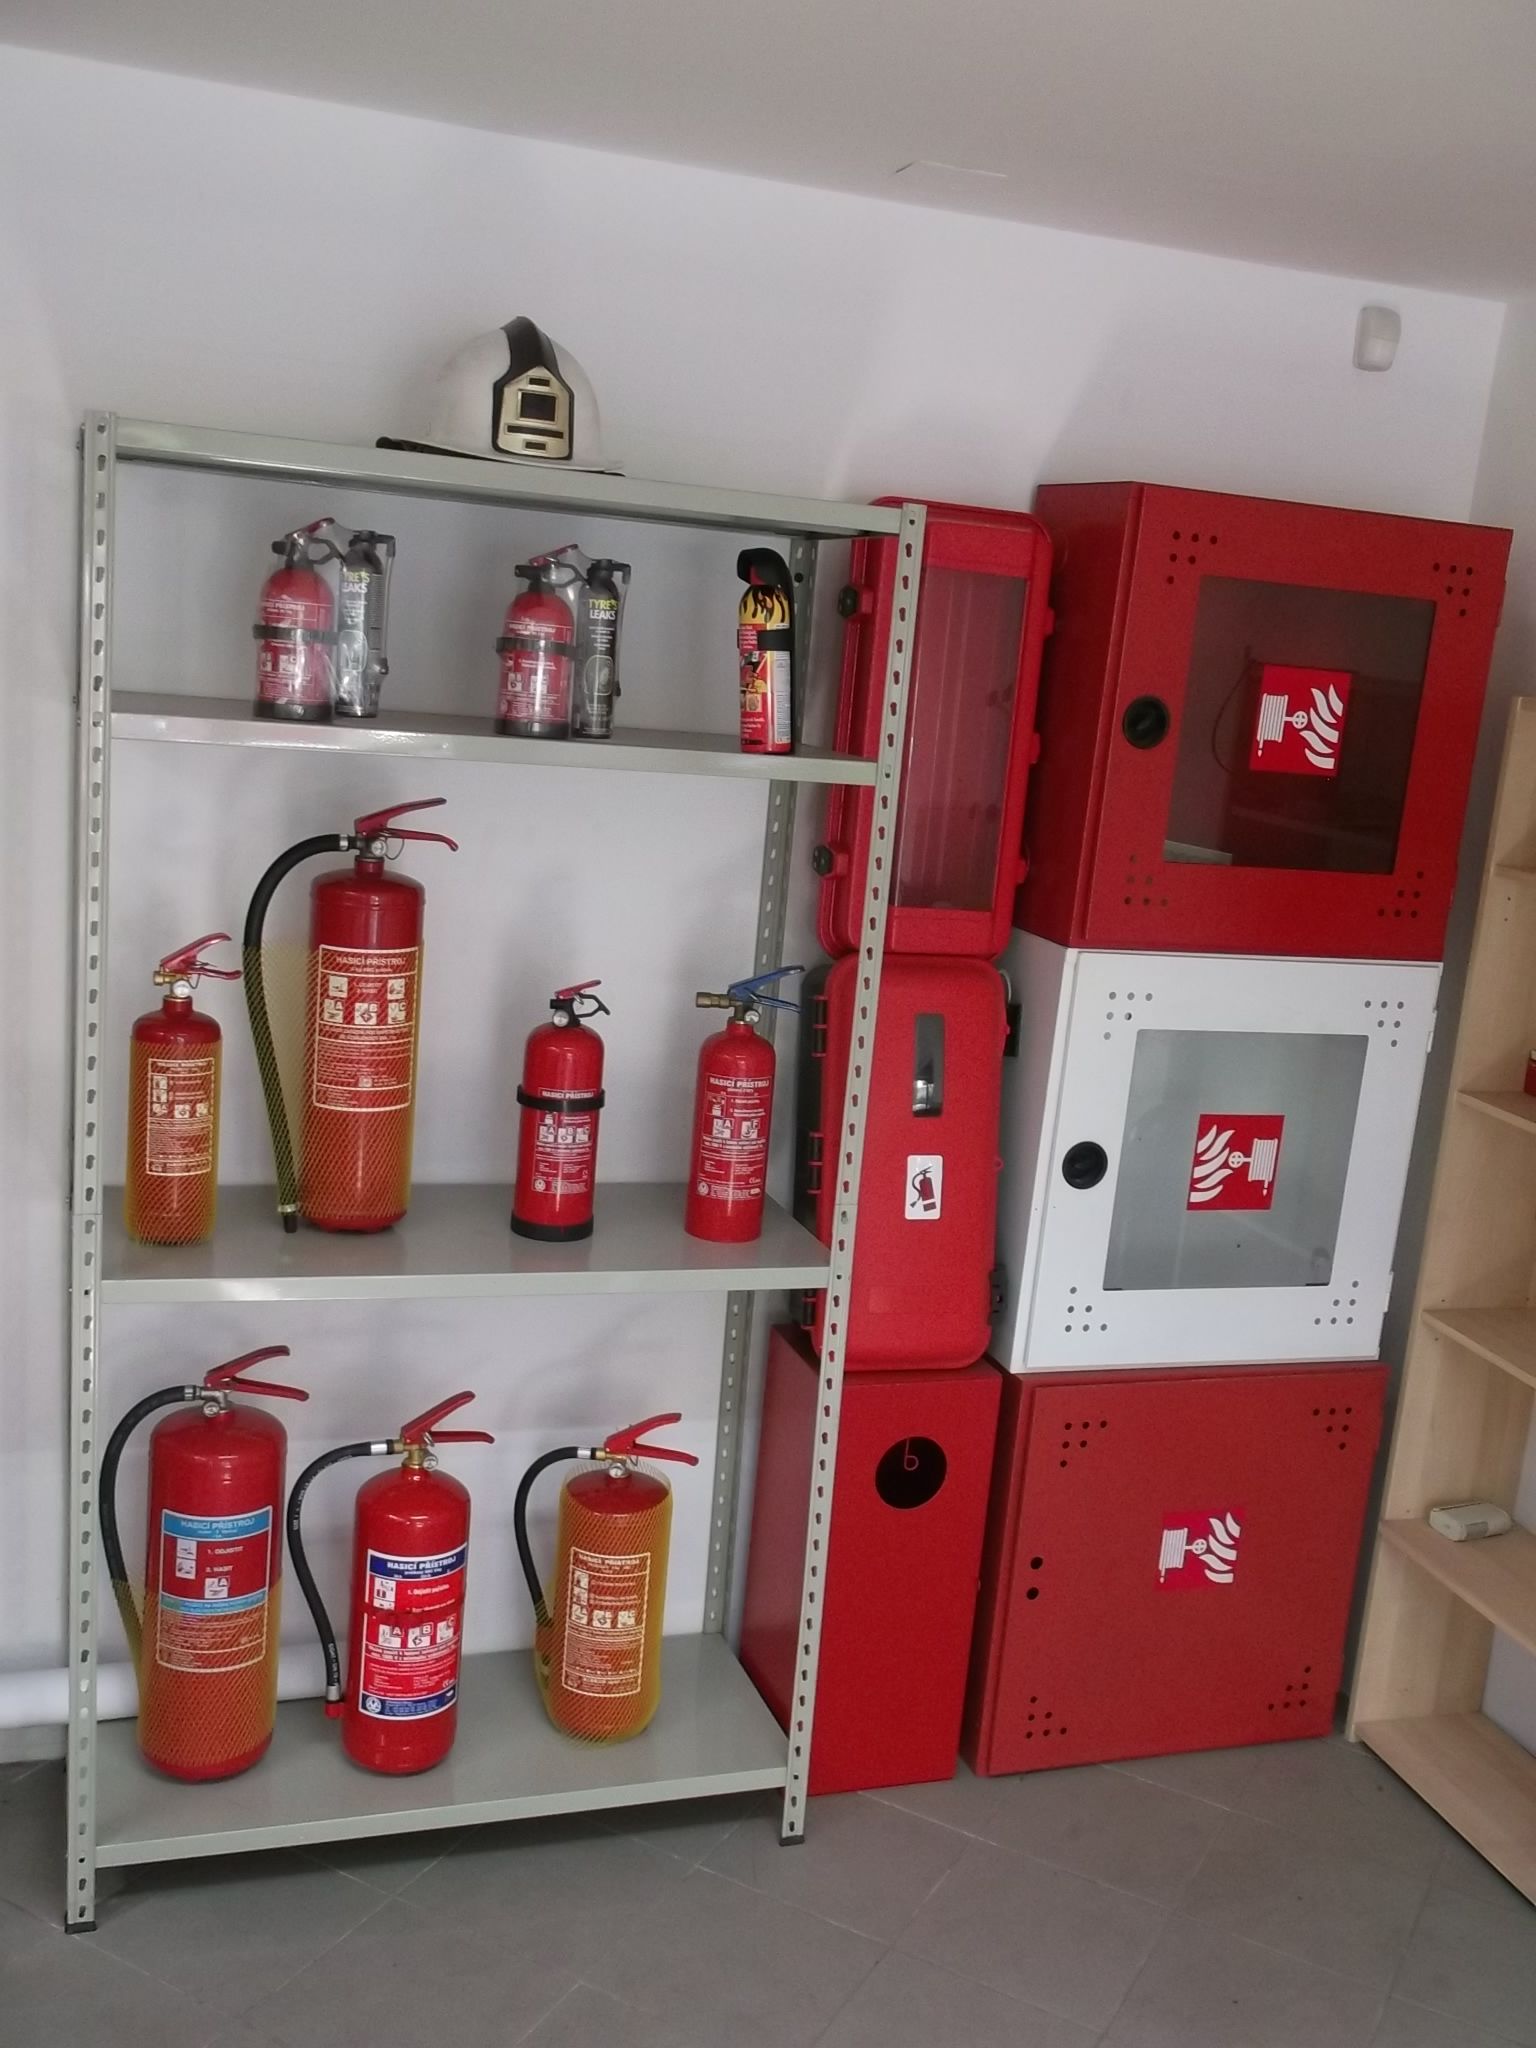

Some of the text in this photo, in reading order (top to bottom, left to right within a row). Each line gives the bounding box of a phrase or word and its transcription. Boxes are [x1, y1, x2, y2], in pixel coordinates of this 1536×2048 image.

[590, 609, 616, 620] LEAKS
[386, 1555, 457, 1571] HASICÍ PŘÍSTROJ
